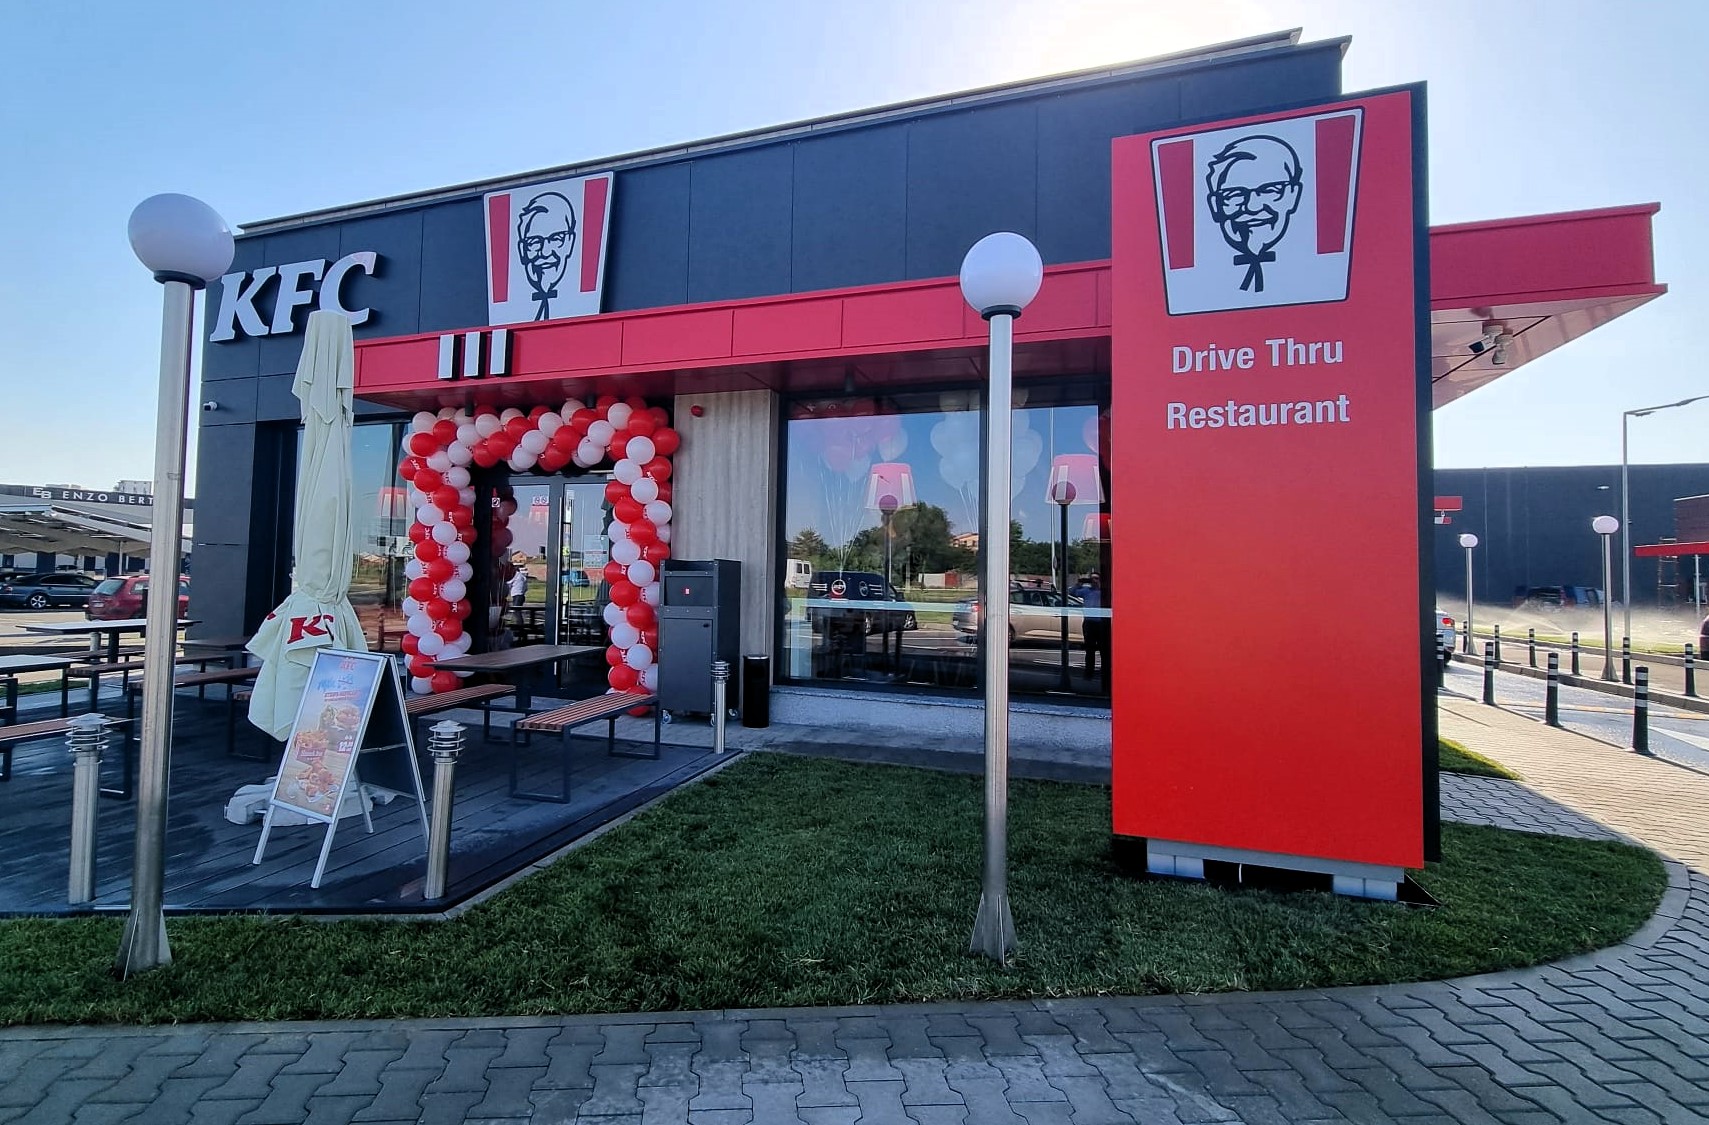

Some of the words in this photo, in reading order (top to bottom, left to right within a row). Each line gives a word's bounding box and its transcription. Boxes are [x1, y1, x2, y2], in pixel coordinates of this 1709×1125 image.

[210, 251, 377, 342] KFC
[1172, 344, 1255, 374] Drive
[1265, 338, 1343, 367] Thru
[1167, 394, 1351, 430] Restaurant
[62, 490, 108, 502] ENZO
